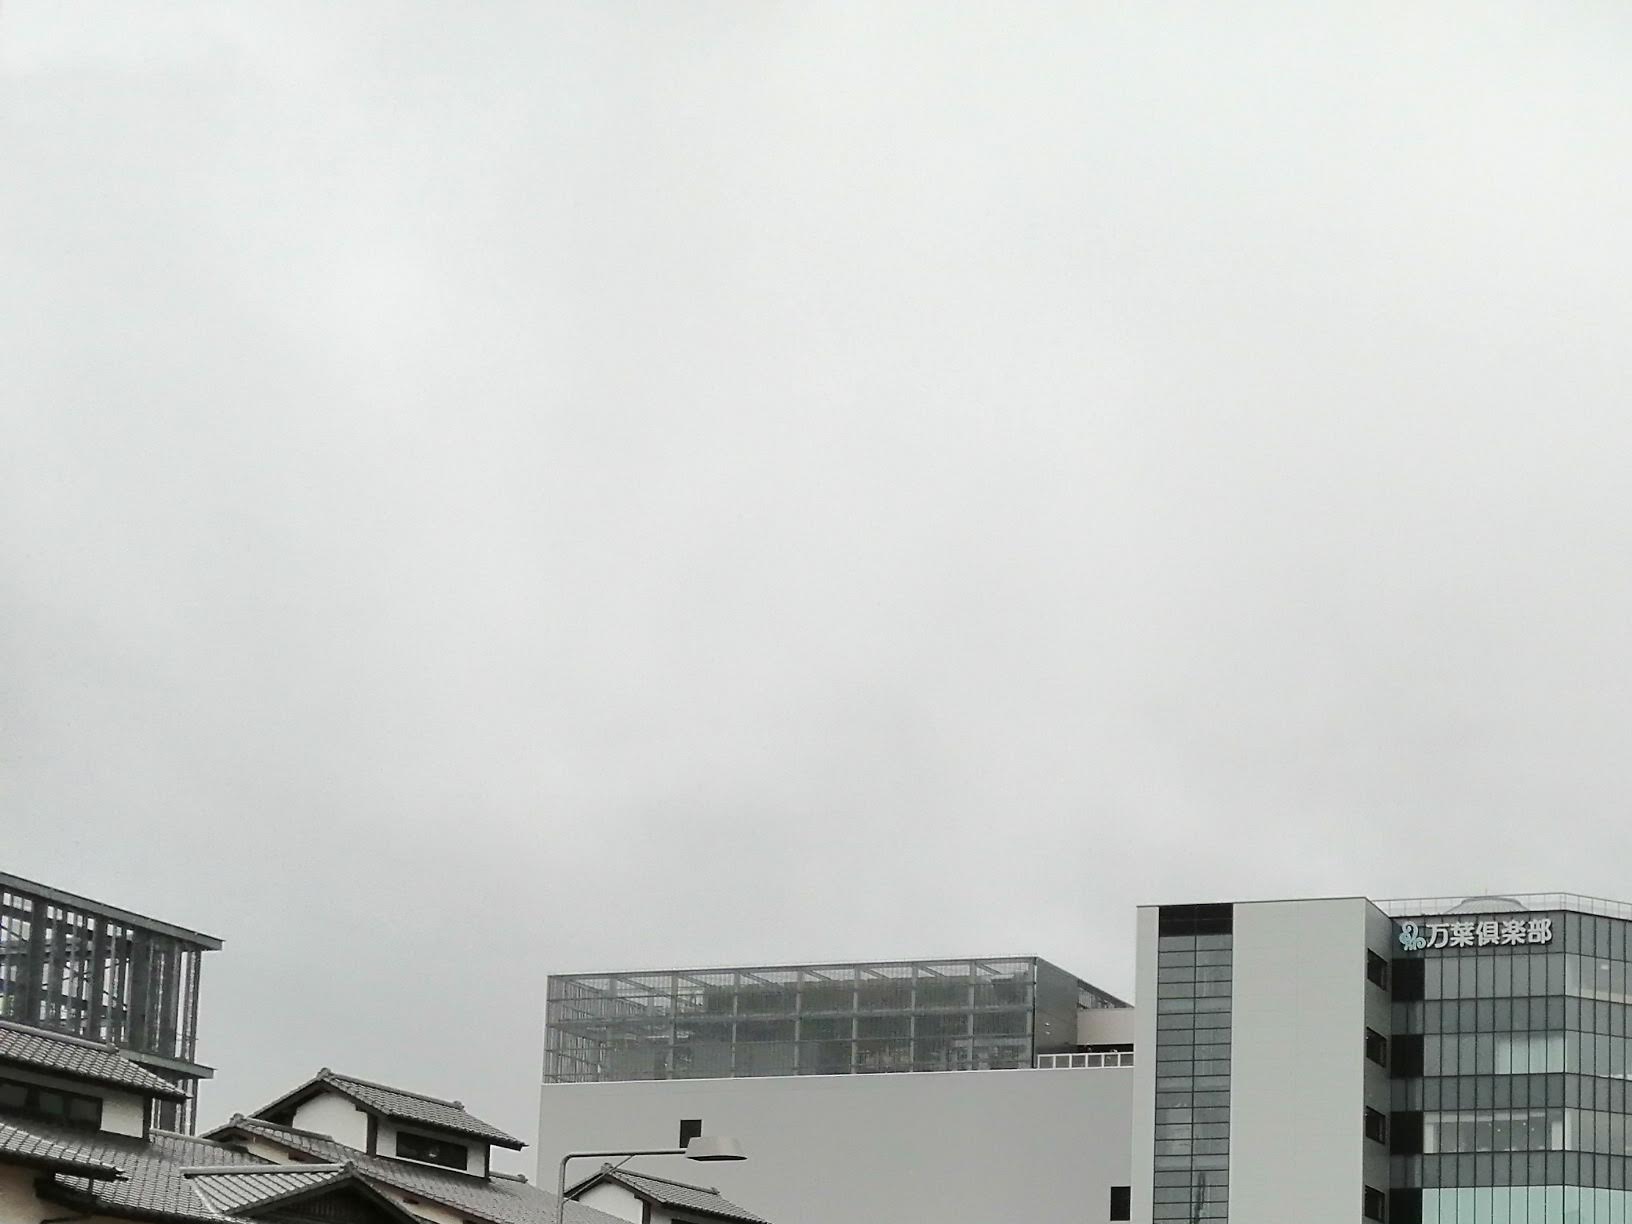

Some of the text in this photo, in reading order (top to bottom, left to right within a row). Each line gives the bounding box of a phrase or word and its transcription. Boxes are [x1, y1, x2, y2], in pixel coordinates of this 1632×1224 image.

[1426, 918, 1553, 949] 万葉倶楽部
